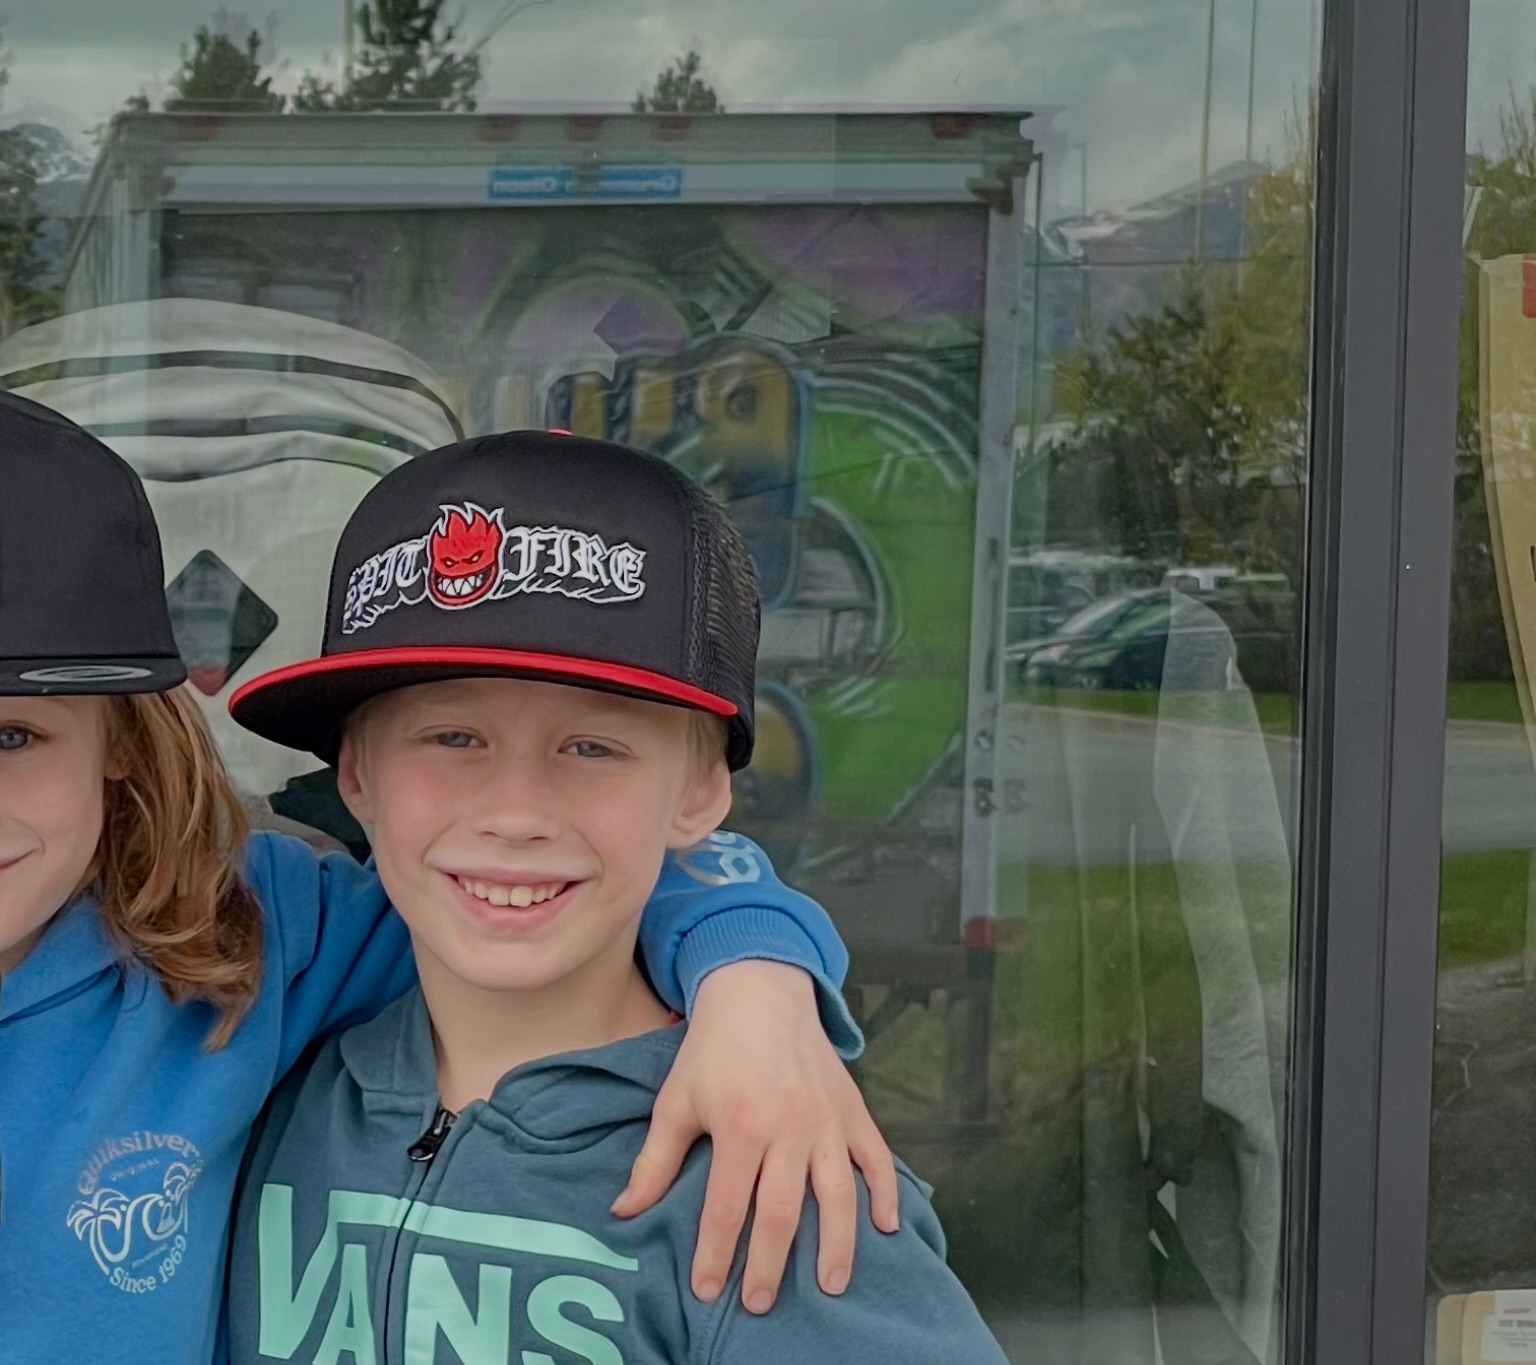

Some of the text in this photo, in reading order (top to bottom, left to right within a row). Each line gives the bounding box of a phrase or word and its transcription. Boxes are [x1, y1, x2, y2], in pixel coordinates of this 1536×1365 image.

[500, 525, 647, 602] FIRE
[109, 1234, 188, 1294] Since 1969
